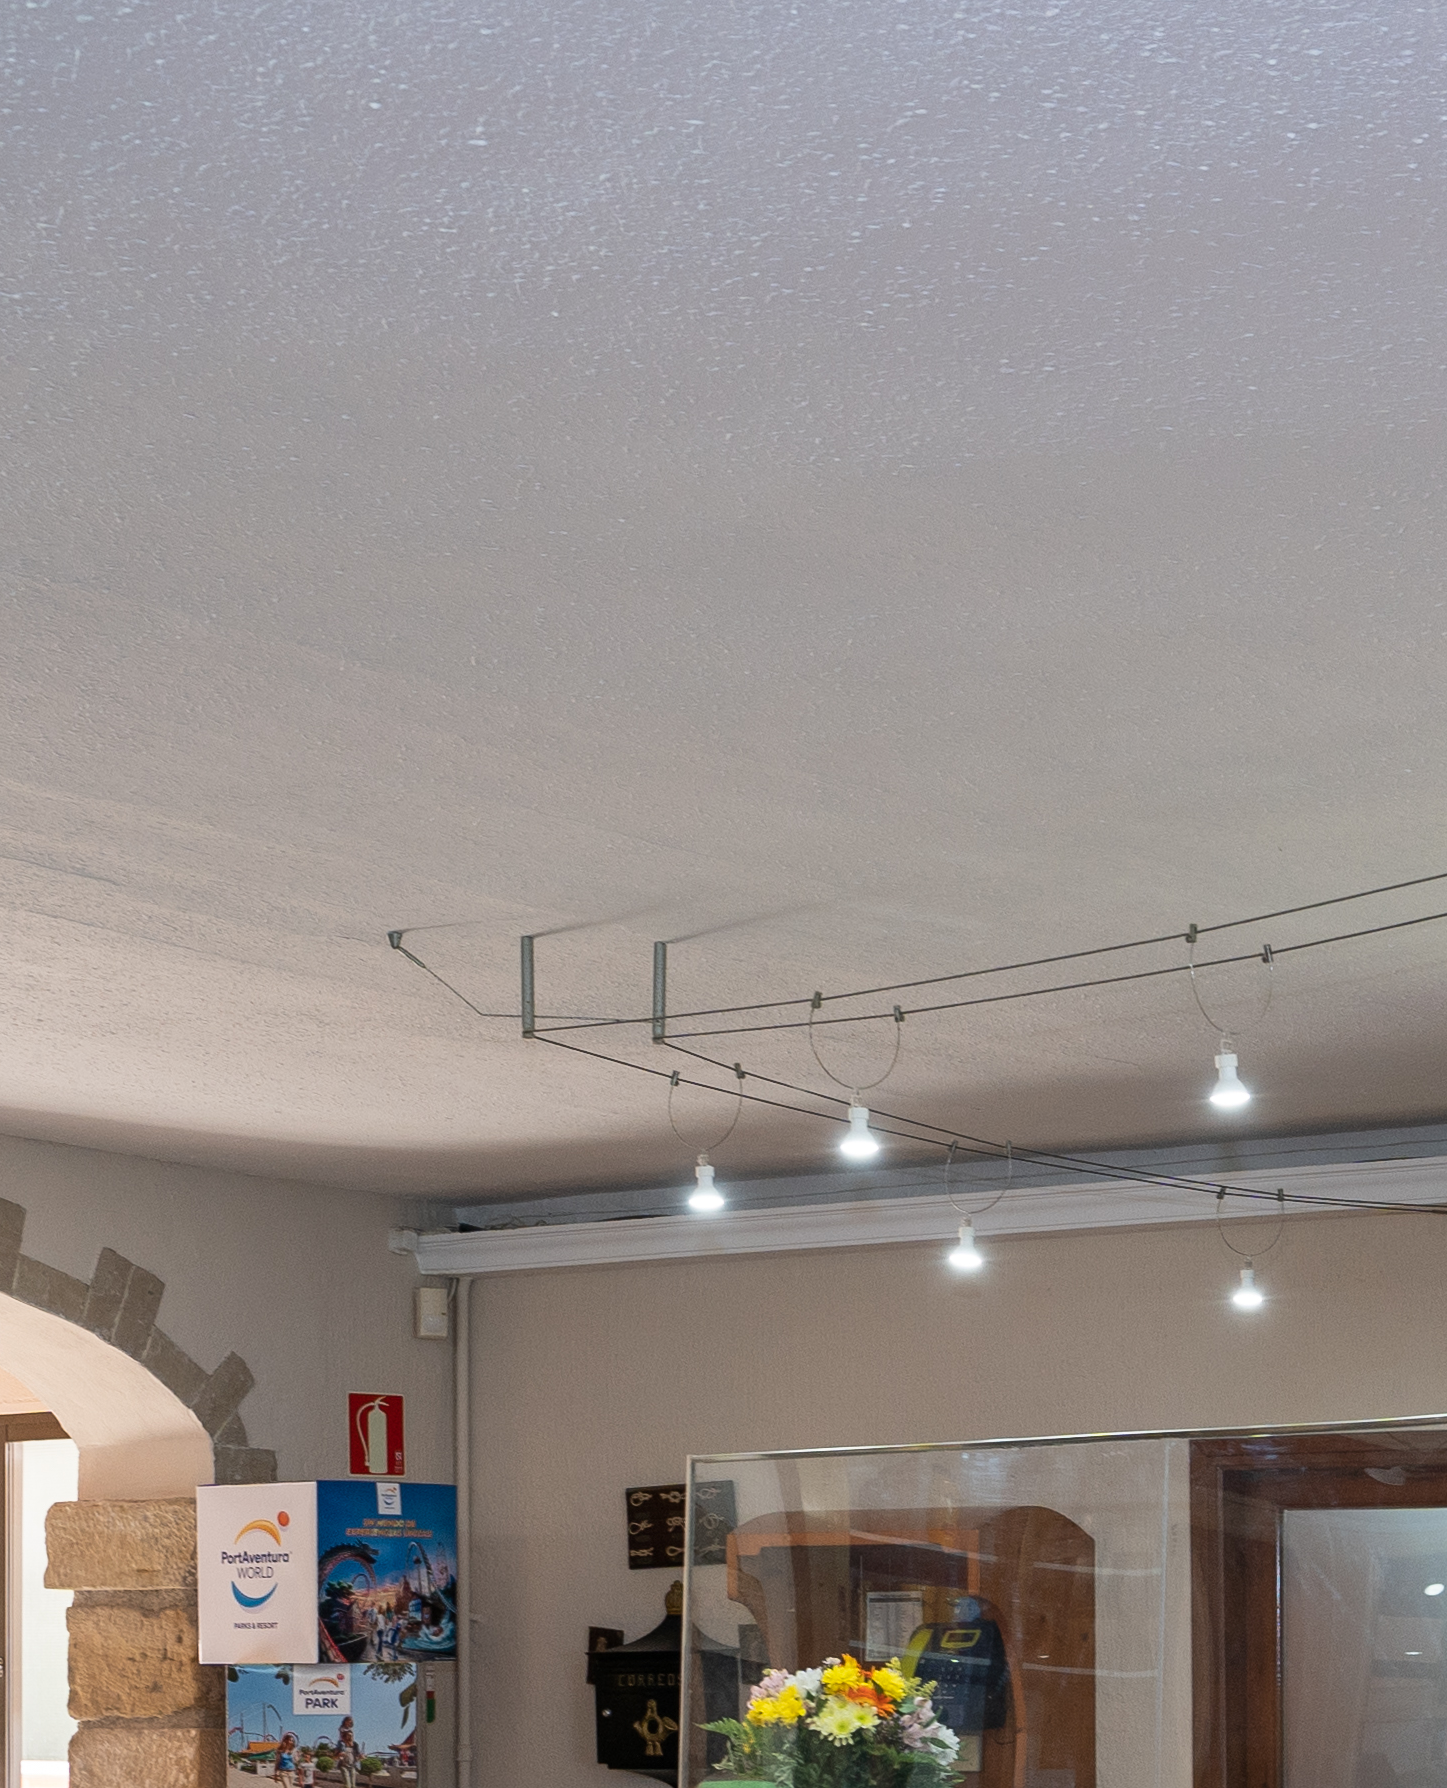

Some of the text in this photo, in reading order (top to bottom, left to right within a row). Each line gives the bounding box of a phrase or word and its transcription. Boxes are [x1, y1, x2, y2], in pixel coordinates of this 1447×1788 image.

[221, 1551, 290, 1564] PortAventura
[237, 1566, 274, 1579] WORLD
[305, 1697, 339, 1709] PARK
